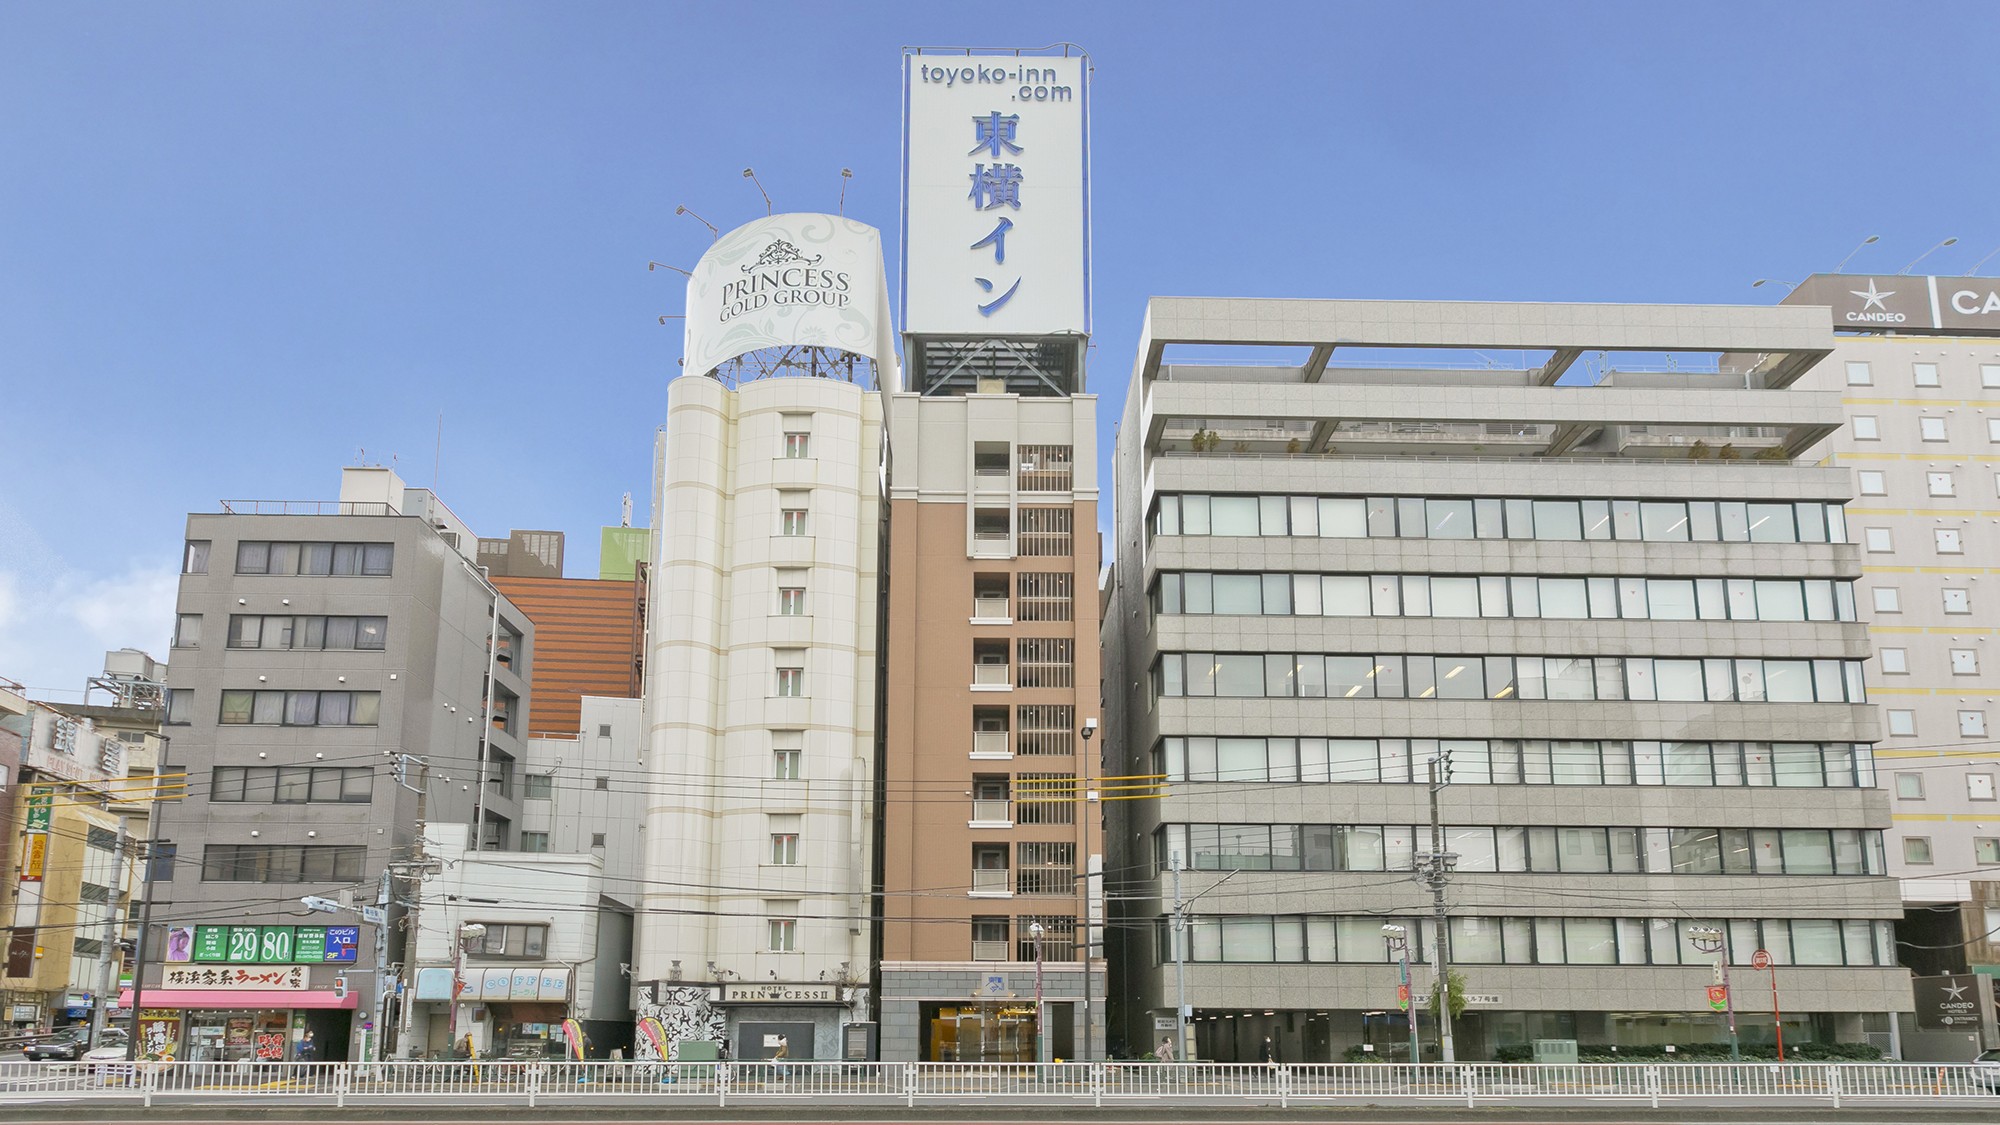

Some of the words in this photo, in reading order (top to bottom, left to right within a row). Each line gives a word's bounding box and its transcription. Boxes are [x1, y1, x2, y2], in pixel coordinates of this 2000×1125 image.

[921, 64, 1057, 87] toyoko-inn
[1011, 84, 1073, 102] .com
[967, 110, 1025, 318] 東横イン
[722, 268, 849, 305] PRINCESS
[720, 293, 767, 323] GOLD
[773, 289, 849, 308] GROUP
[1846, 311, 1906, 323] CANDEO
[168, 969, 287, 985] 横浜家系ラーメン
[485, 975, 565, 989] COFFEE
[761, 986, 787, 994] HOTEL
